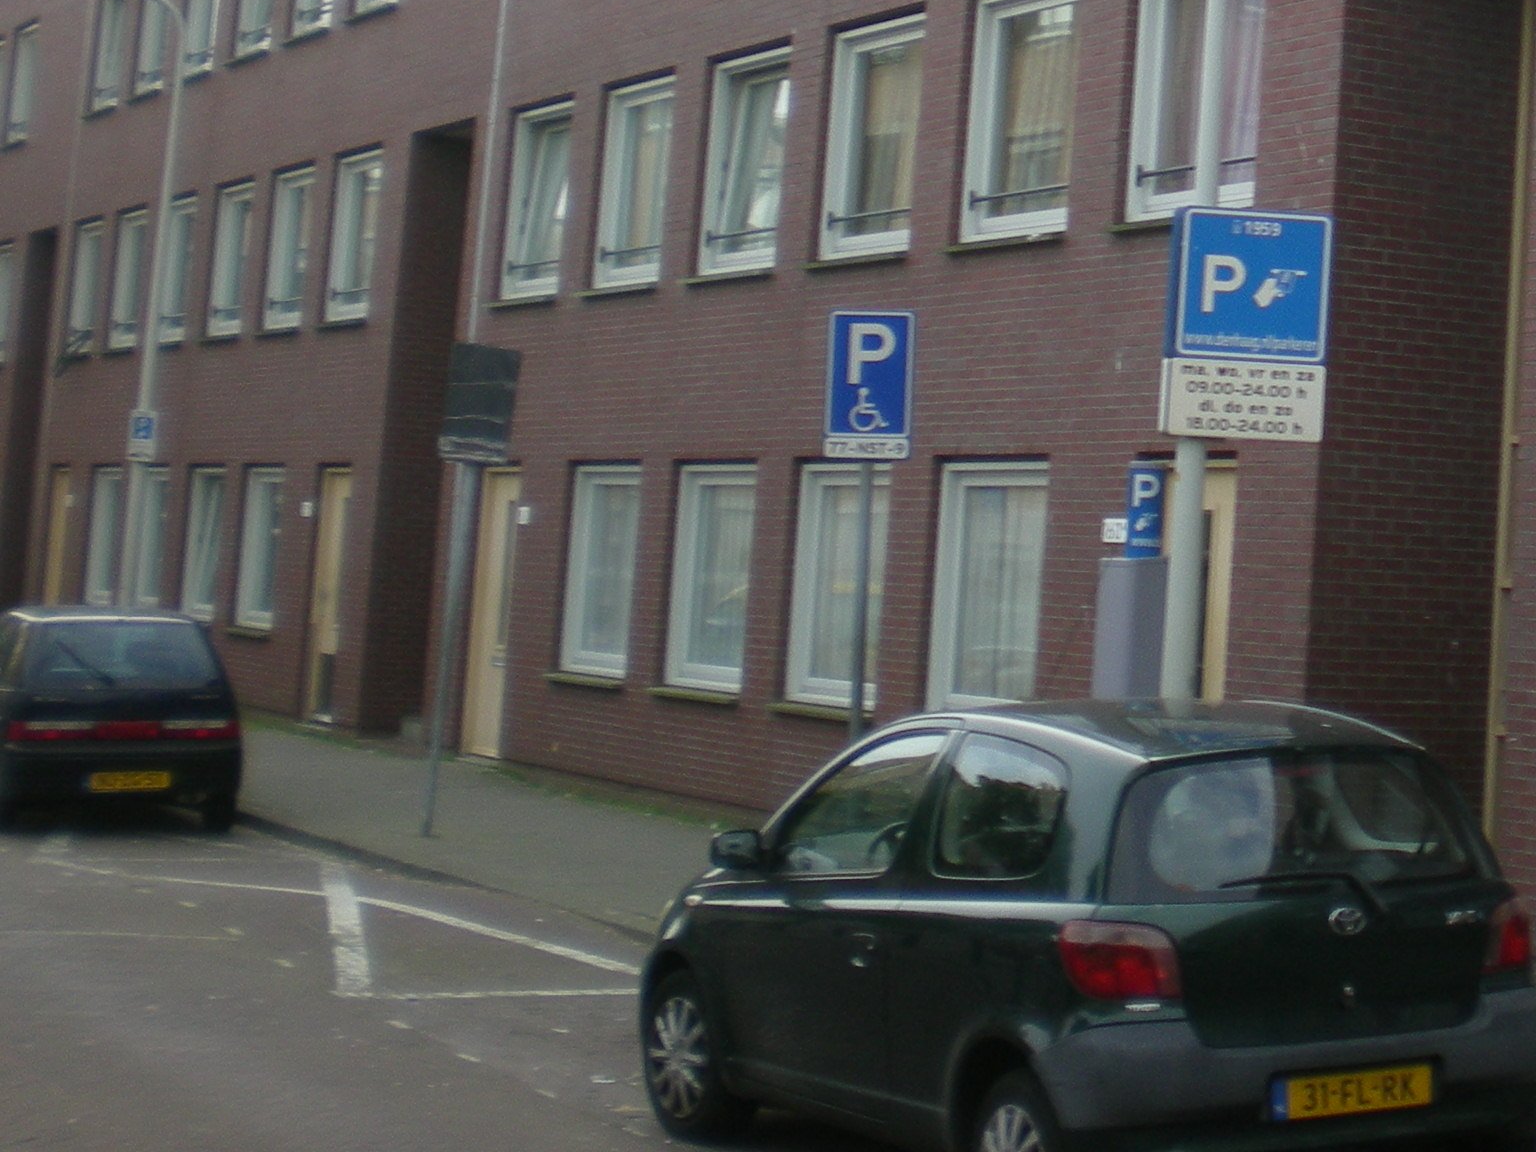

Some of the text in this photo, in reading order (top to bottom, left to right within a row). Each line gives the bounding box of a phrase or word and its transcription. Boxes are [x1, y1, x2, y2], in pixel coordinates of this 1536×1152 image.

[1201, 254, 1247, 313] P
[847, 322, 897, 385] P
[1270, 370, 1290, 380] en
[1248, 405, 1268, 415] en
[1131, 474, 1160, 507] P
[1303, 1072, 1416, 1112] 31-FL-RK
